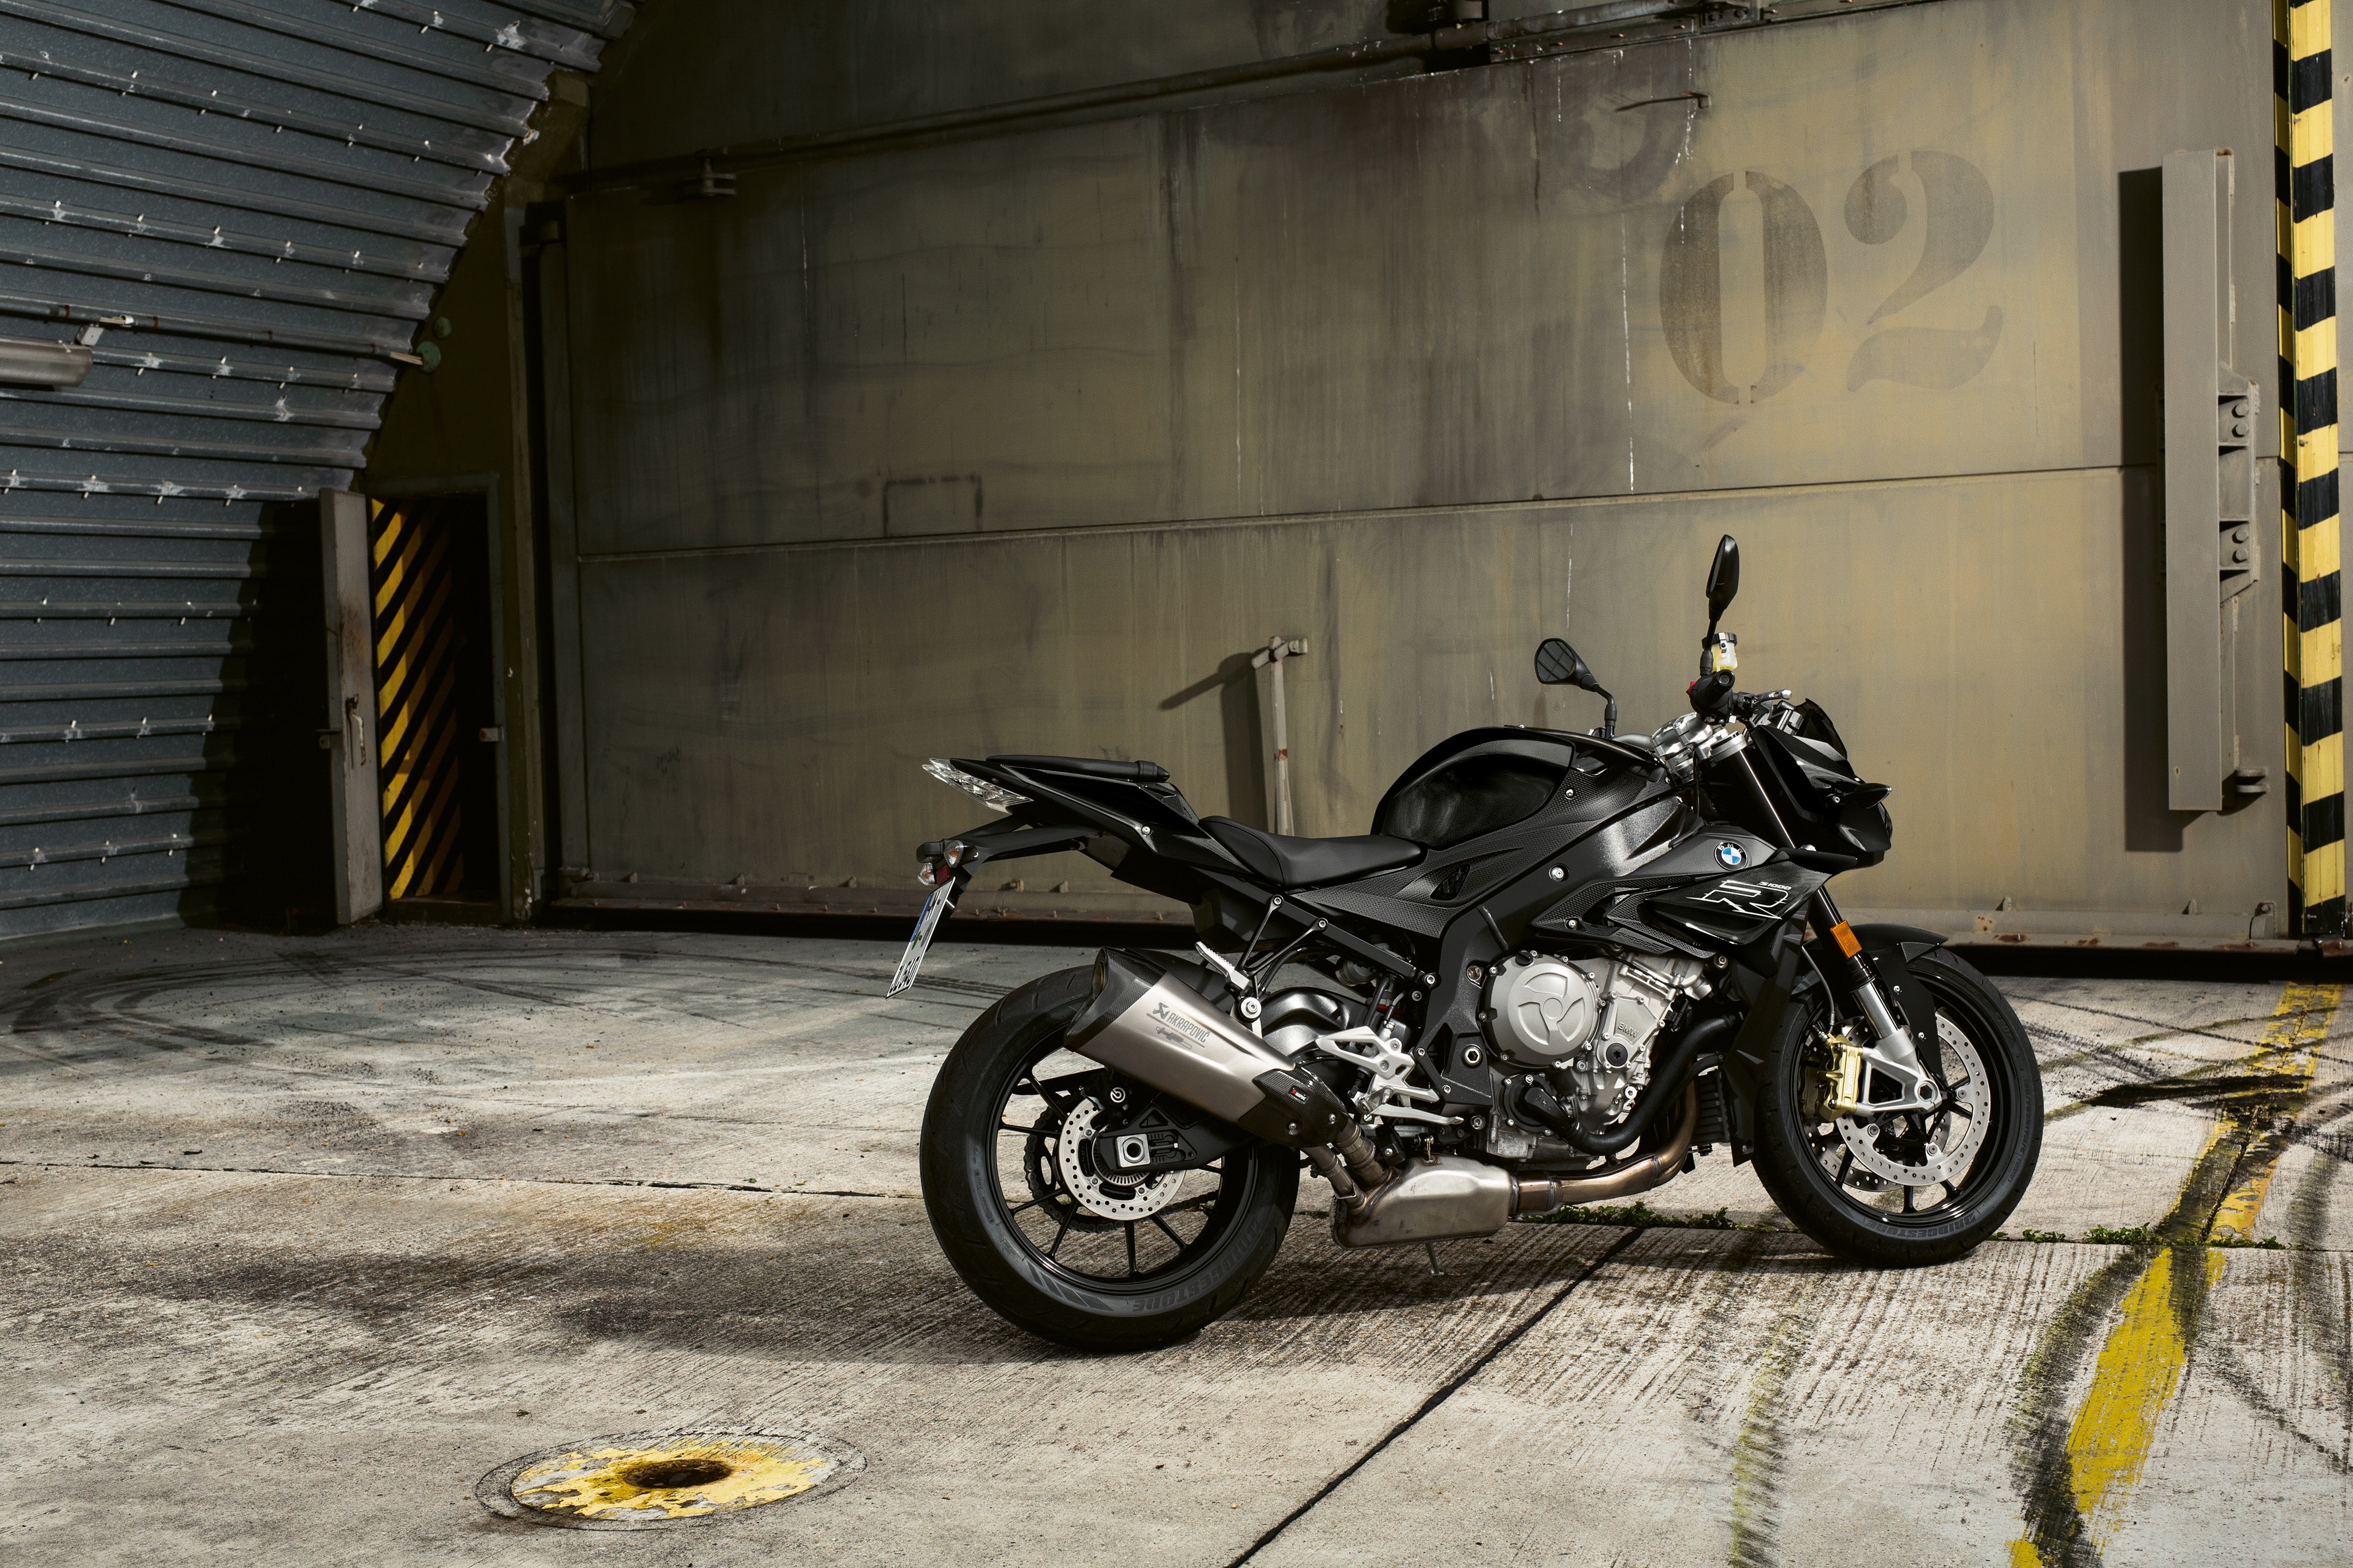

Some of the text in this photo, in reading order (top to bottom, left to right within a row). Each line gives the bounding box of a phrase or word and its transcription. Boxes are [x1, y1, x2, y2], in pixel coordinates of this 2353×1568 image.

[1660, 150, 2003, 404] 02
[1758, 881, 1792, 890] S1000
[1166, 1013, 1210, 1043] AKRAPOVIČ
[1618, 1022, 1639, 1038] BMW
[1845, 1061, 1854, 1094] brembo
[1866, 1211, 1976, 1238] BRIDGESTONE
[1132, 1216, 1260, 1312] BRIDGESTONE
